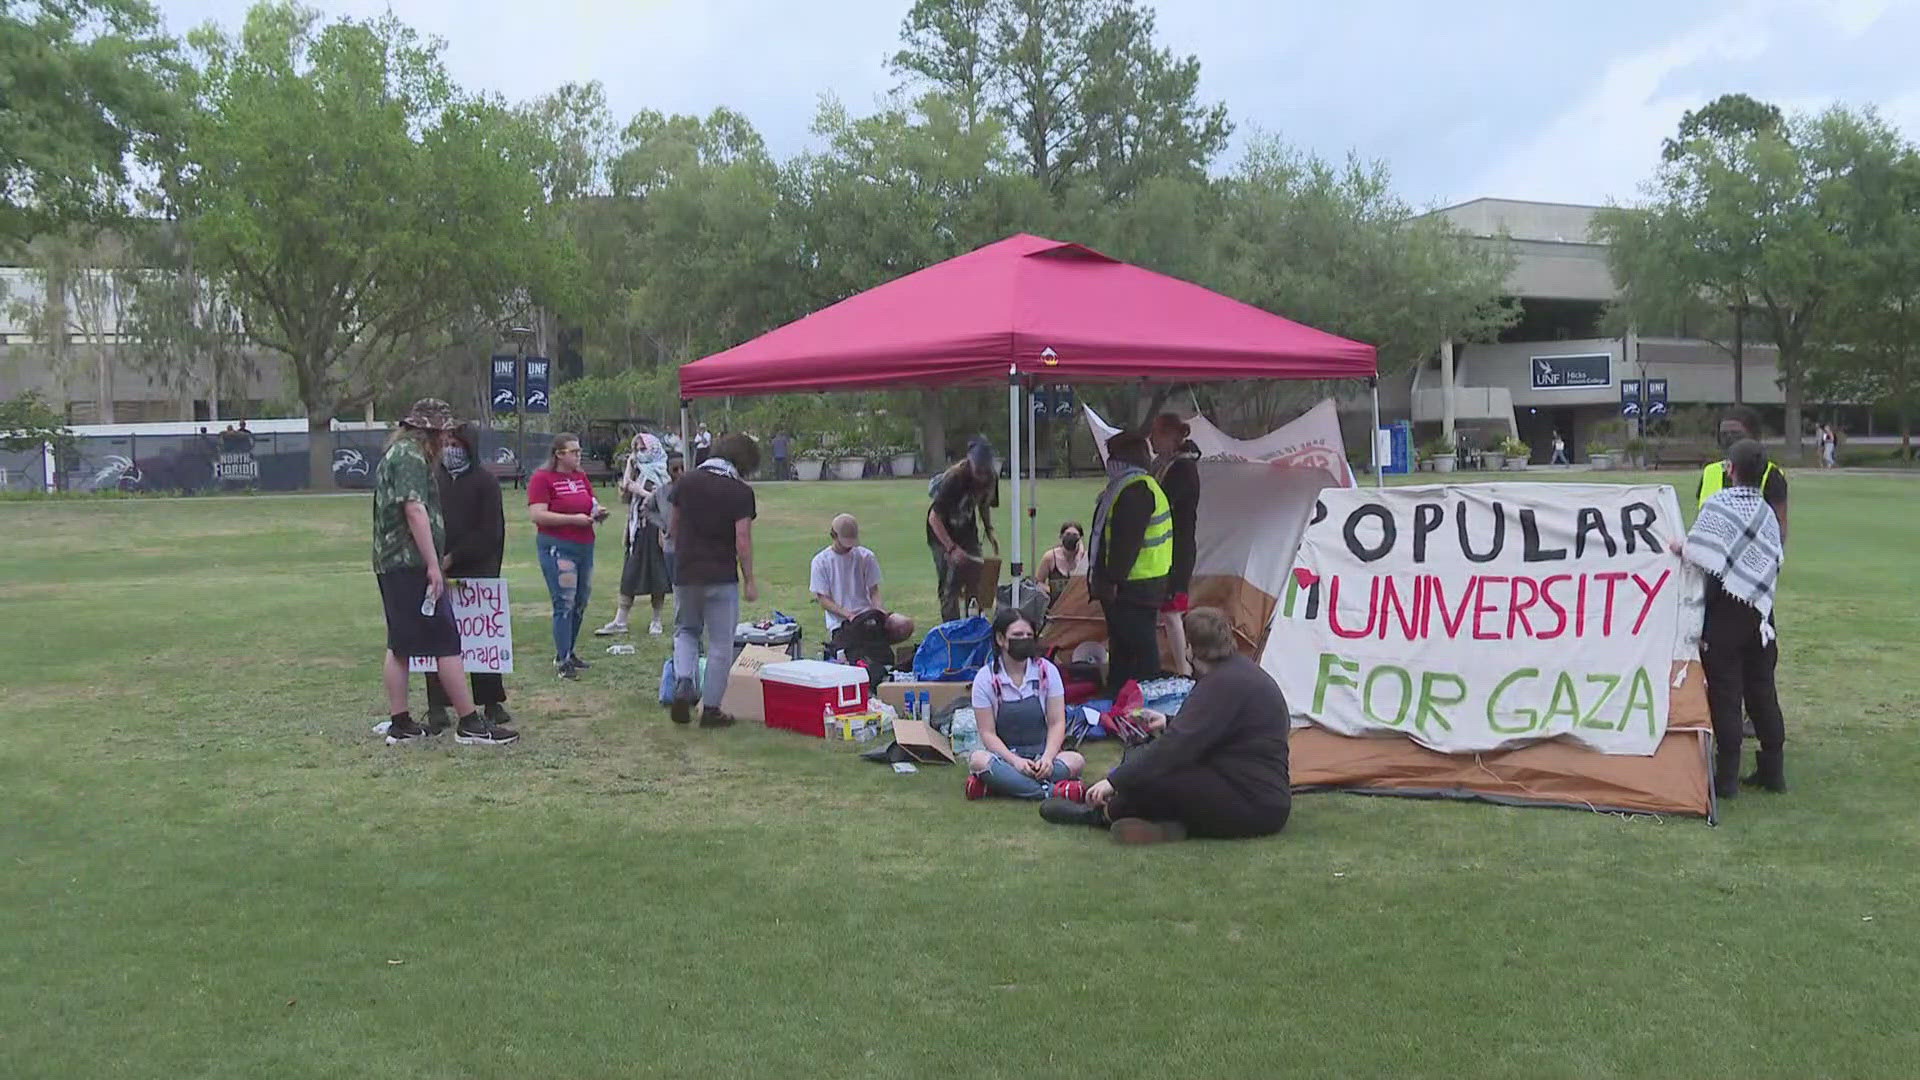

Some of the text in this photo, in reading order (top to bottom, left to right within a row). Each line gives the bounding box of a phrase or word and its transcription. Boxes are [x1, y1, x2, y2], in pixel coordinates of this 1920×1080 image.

[494, 361, 515, 373] UNF
[527, 362, 548, 375] UNF
[1536, 373, 1560, 385] UNF
[1623, 383, 1639, 392] UNF
[1650, 383, 1665, 392] UNF
[220, 454, 250, 464] NORTH
[1328, 569, 1671, 641] UNIVERSITY
[1311, 653, 1658, 738] FOR GAZA
